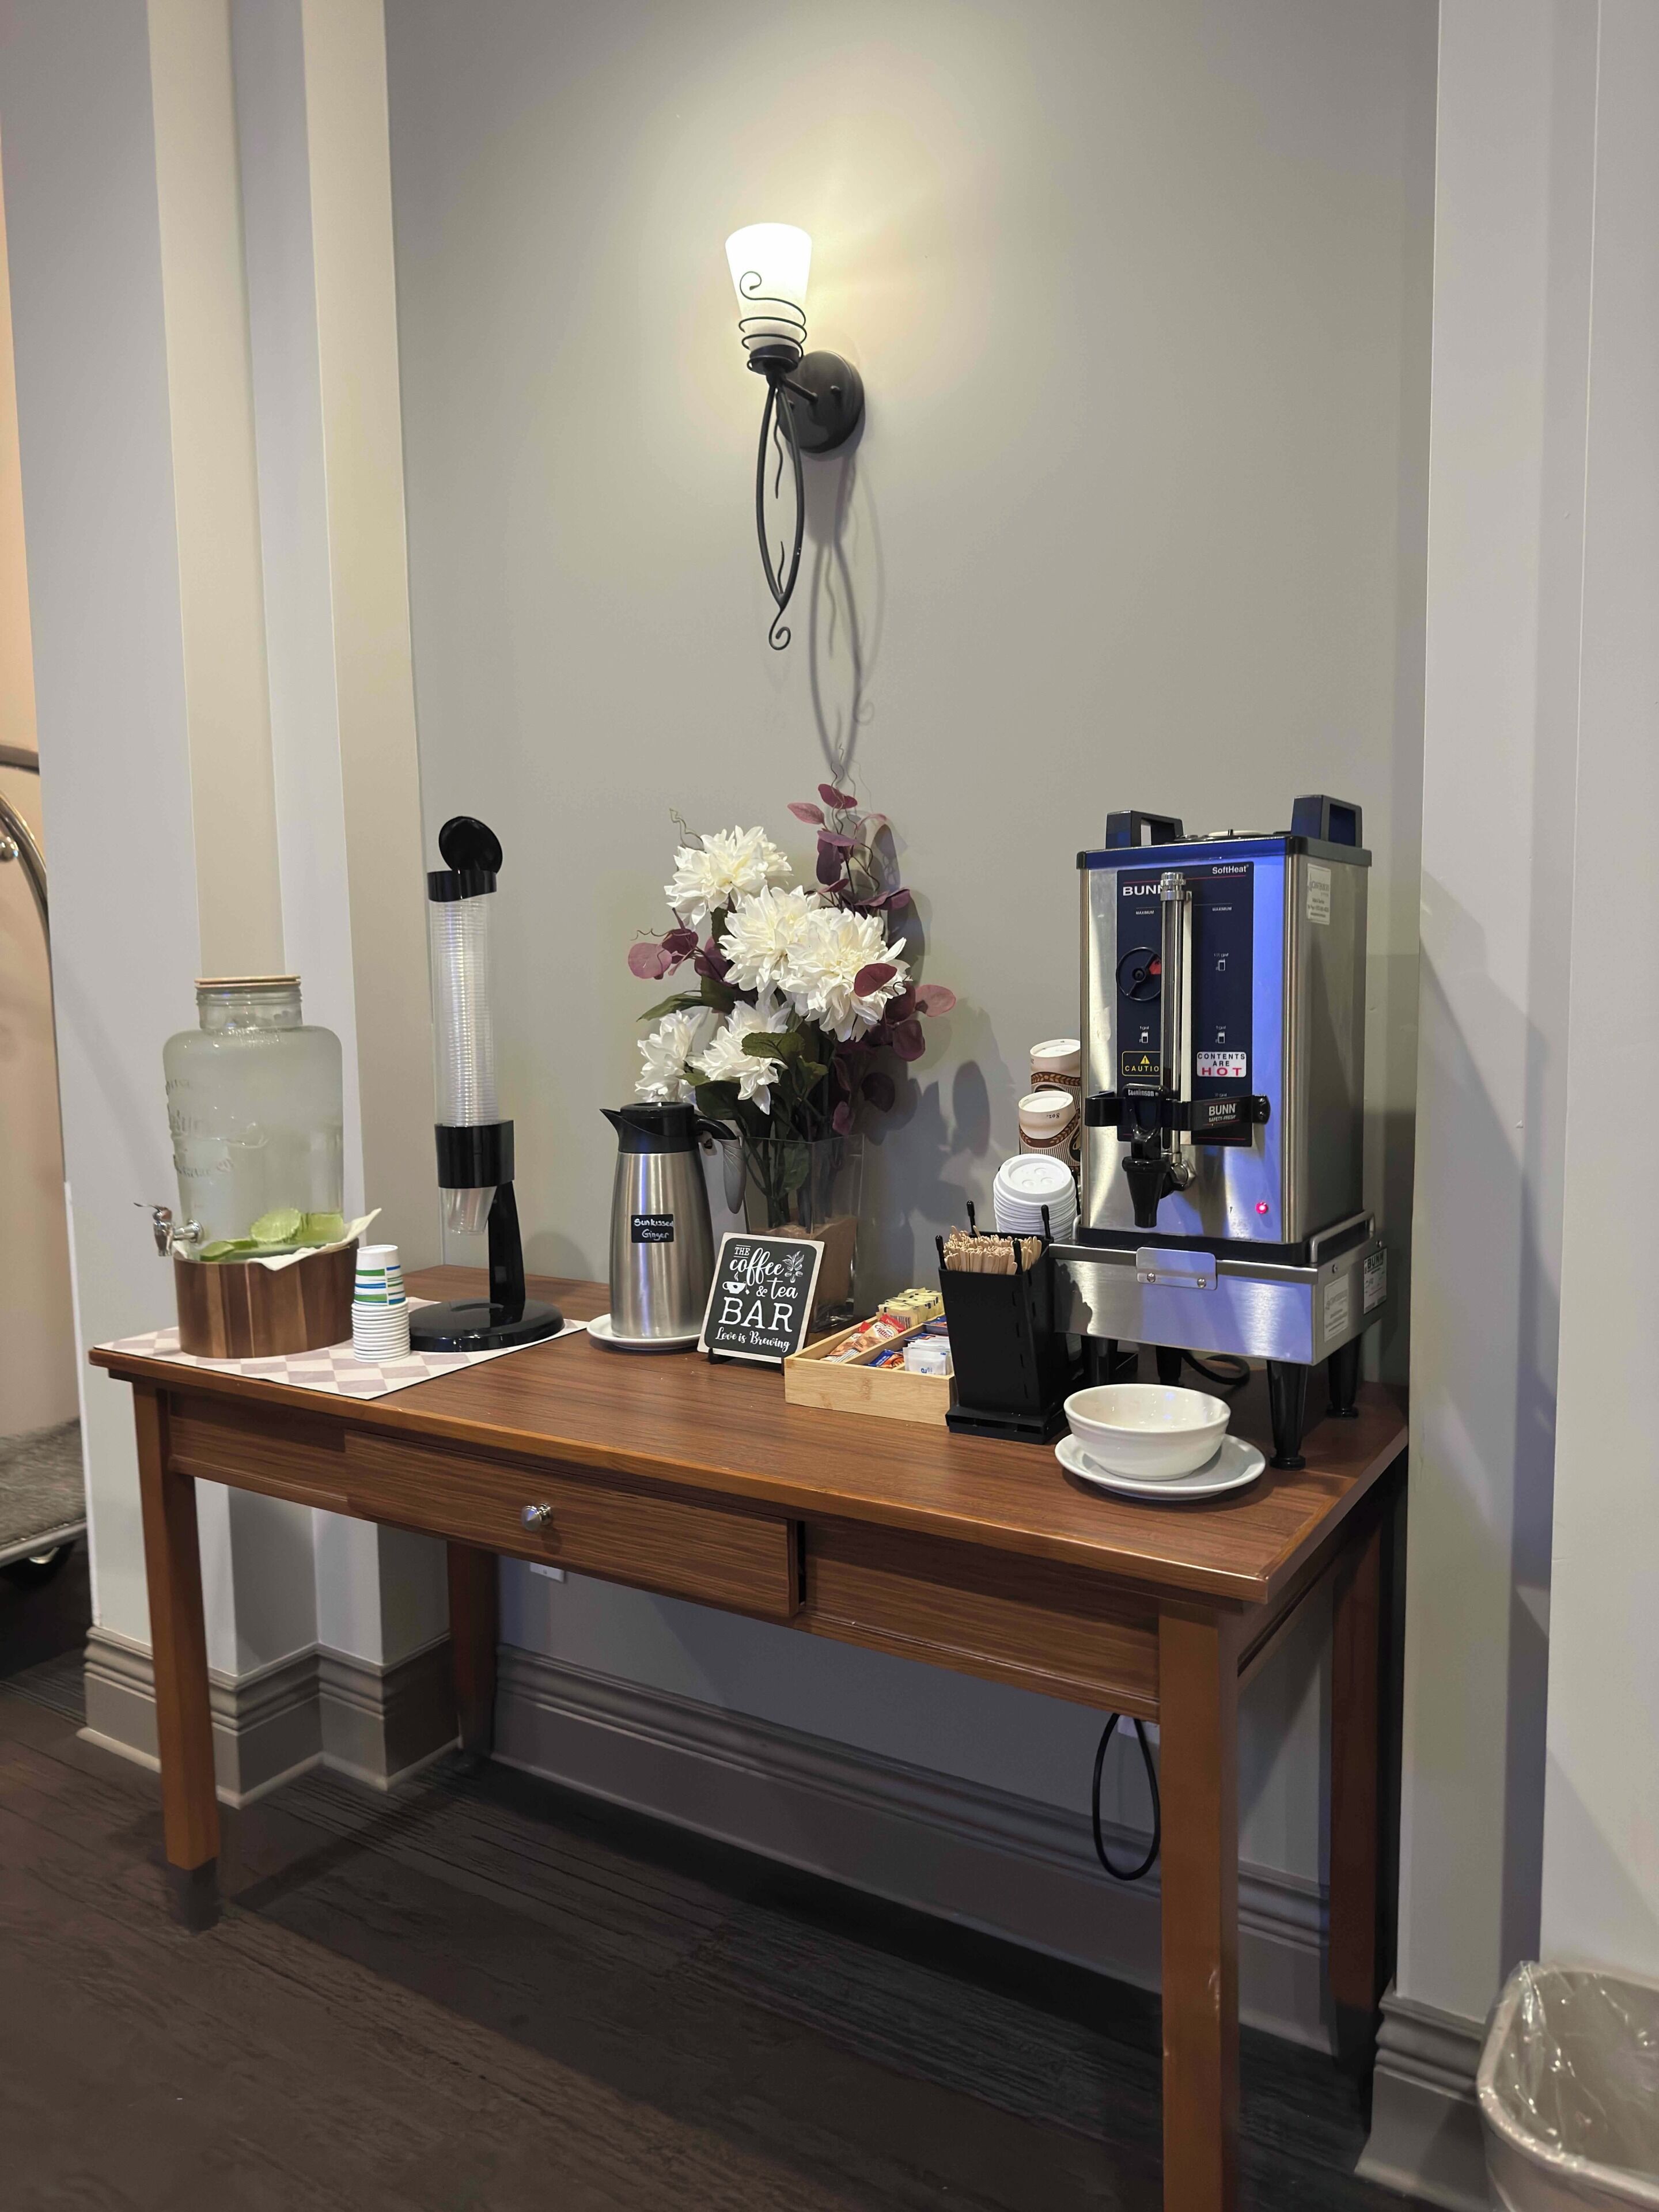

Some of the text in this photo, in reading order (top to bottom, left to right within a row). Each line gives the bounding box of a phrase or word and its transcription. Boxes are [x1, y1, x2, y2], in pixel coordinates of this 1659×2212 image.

[1212, 866, 1247, 874] SoftHeat
[1202, 1067, 1242, 1076] HOT
[1209, 1103, 1236, 1116] BUNN
[634, 1218, 673, 1226] Sunkissed
[642, 1229, 669, 1241] Ginger
[734, 1247, 751, 1256] THE
[729, 1247, 785, 1286] coffee
[756, 1277, 798, 1299] & tea
[718, 1297, 793, 1332] BAR
[715, 1327, 790, 1353] Love is Brewing
